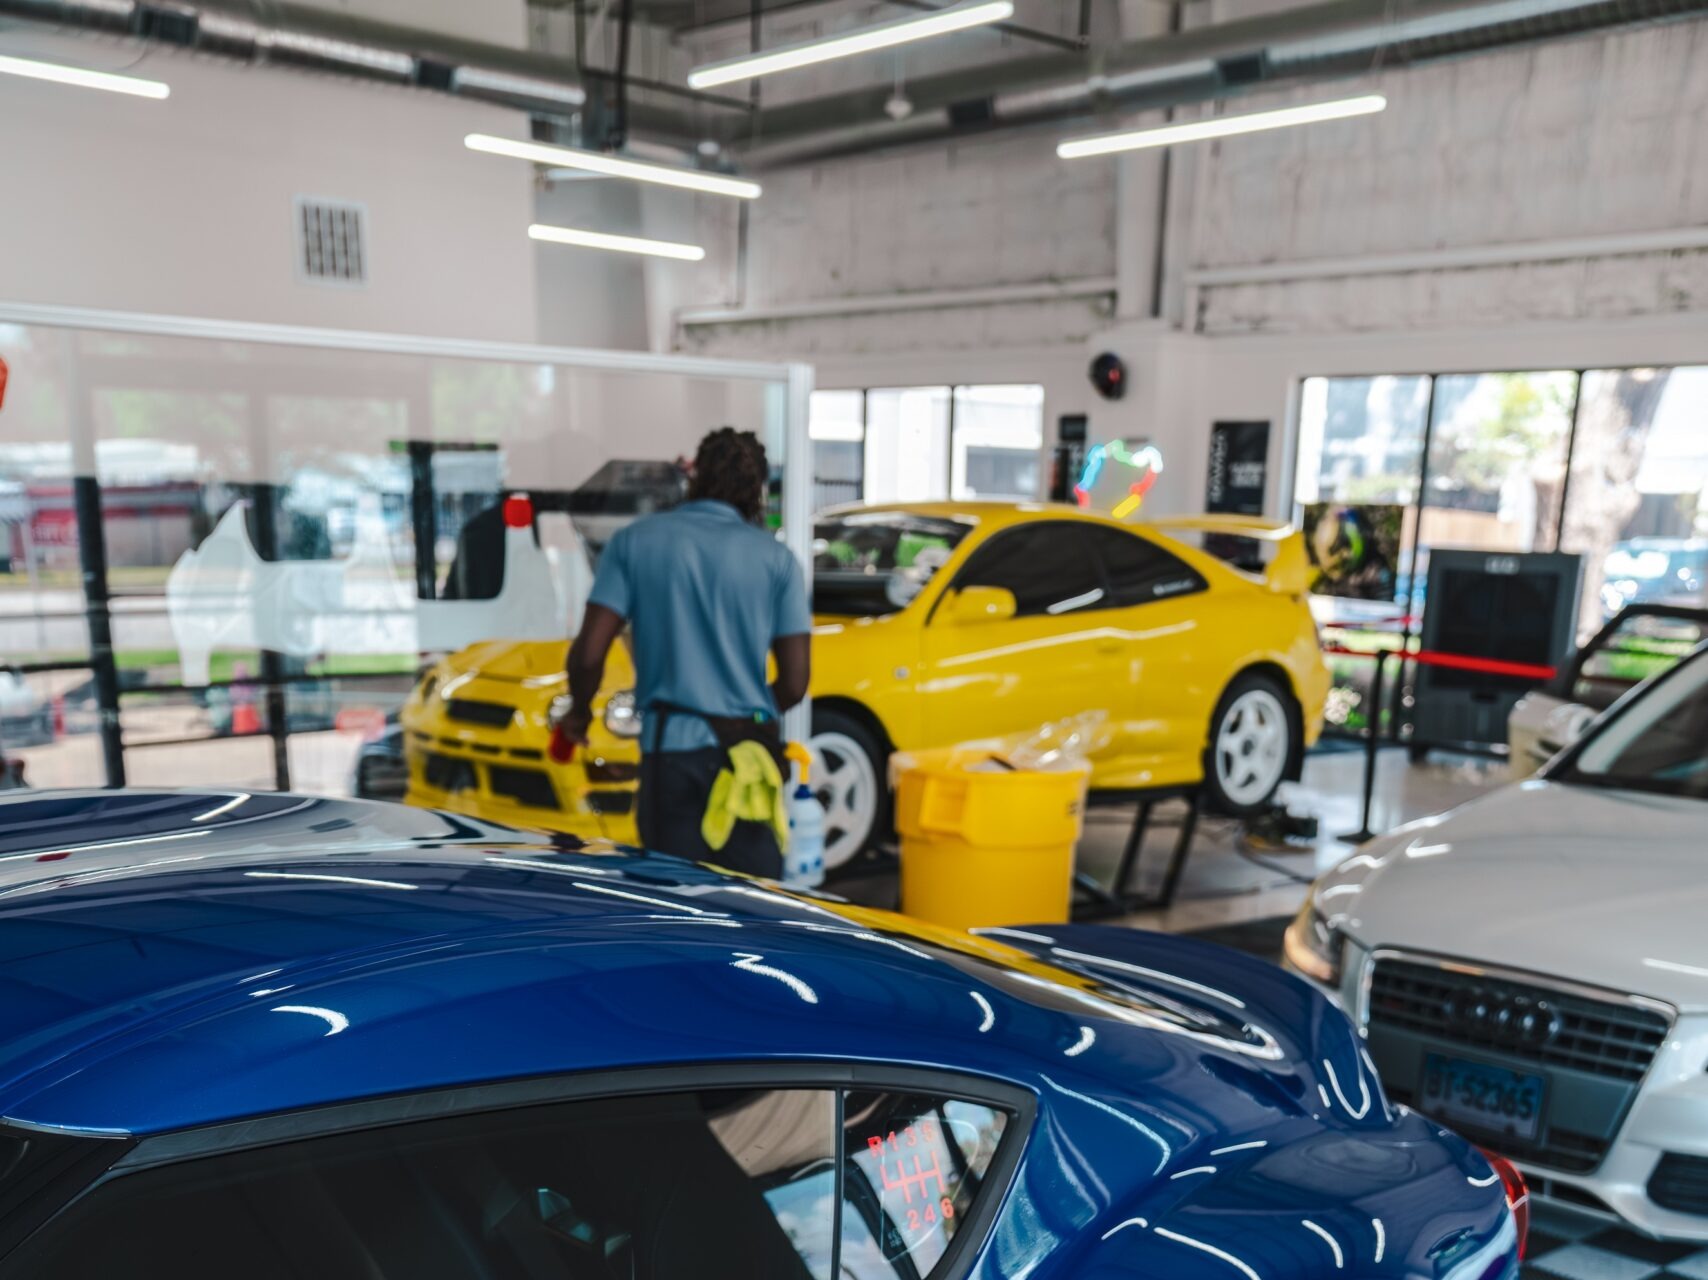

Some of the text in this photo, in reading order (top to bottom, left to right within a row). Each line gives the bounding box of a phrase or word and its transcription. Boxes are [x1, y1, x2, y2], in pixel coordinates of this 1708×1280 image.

[867, 1135, 886, 1158] R
[887, 1130, 899, 1152] 1
[904, 1126, 917, 1147] 3
[906, 1198, 955, 1230] 2 4 6
